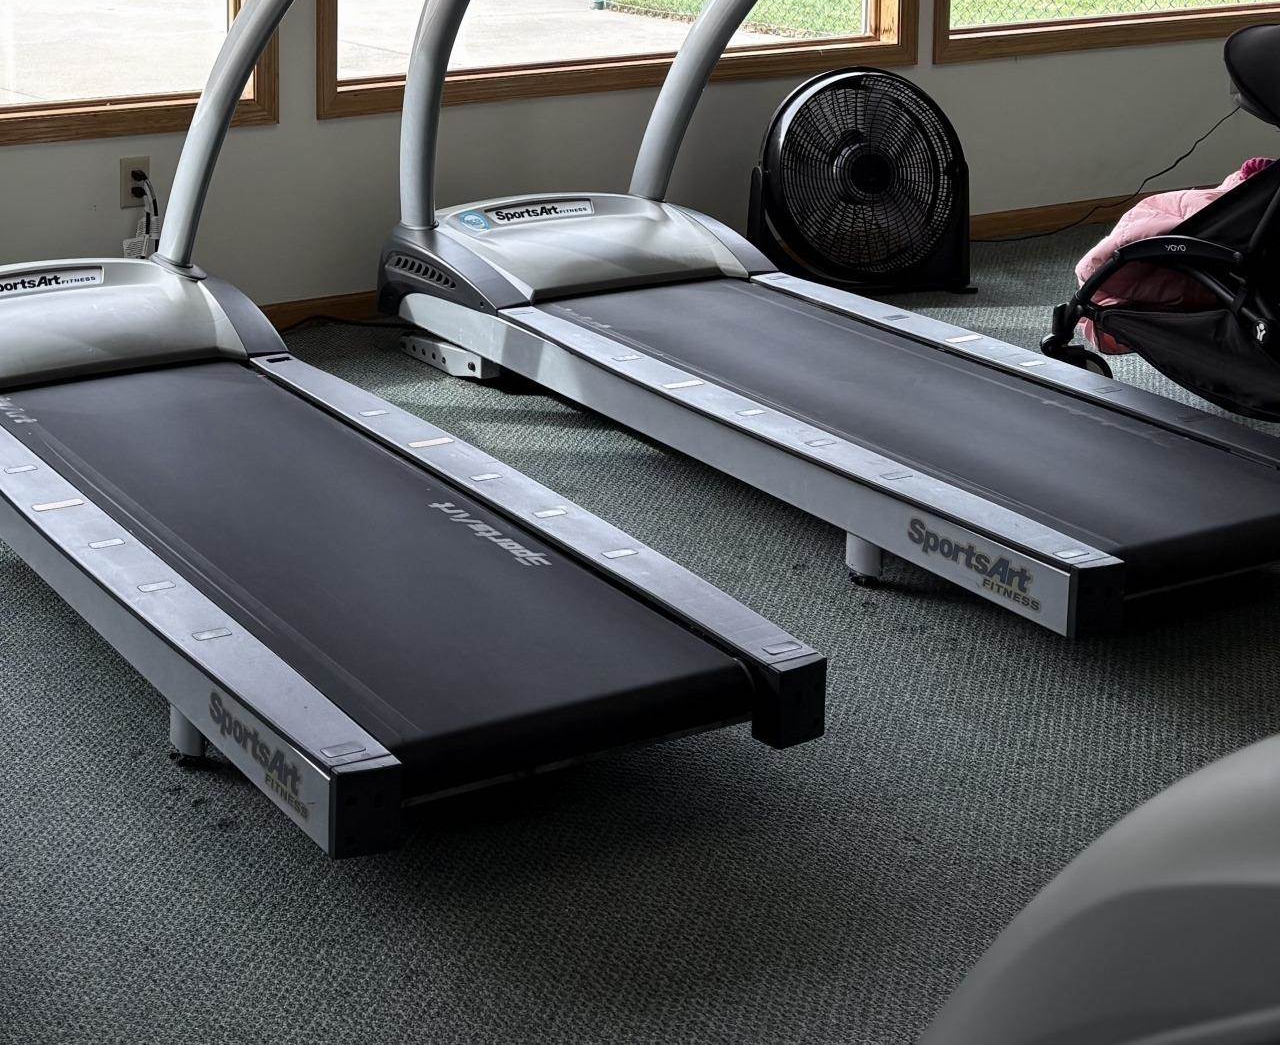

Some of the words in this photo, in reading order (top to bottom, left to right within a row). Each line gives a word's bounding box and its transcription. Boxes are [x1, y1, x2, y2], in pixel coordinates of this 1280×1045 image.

[495, 205, 560, 222] SportsArt
[61, 275, 96, 285] FITNESS
[427, 502, 553, 567] SportsArt
[907, 518, 1032, 593] SportsArt
[982, 578, 1041, 611] FITNESS
[209, 691, 302, 797] SportsArt
[265, 772, 309, 821] FITNESS
